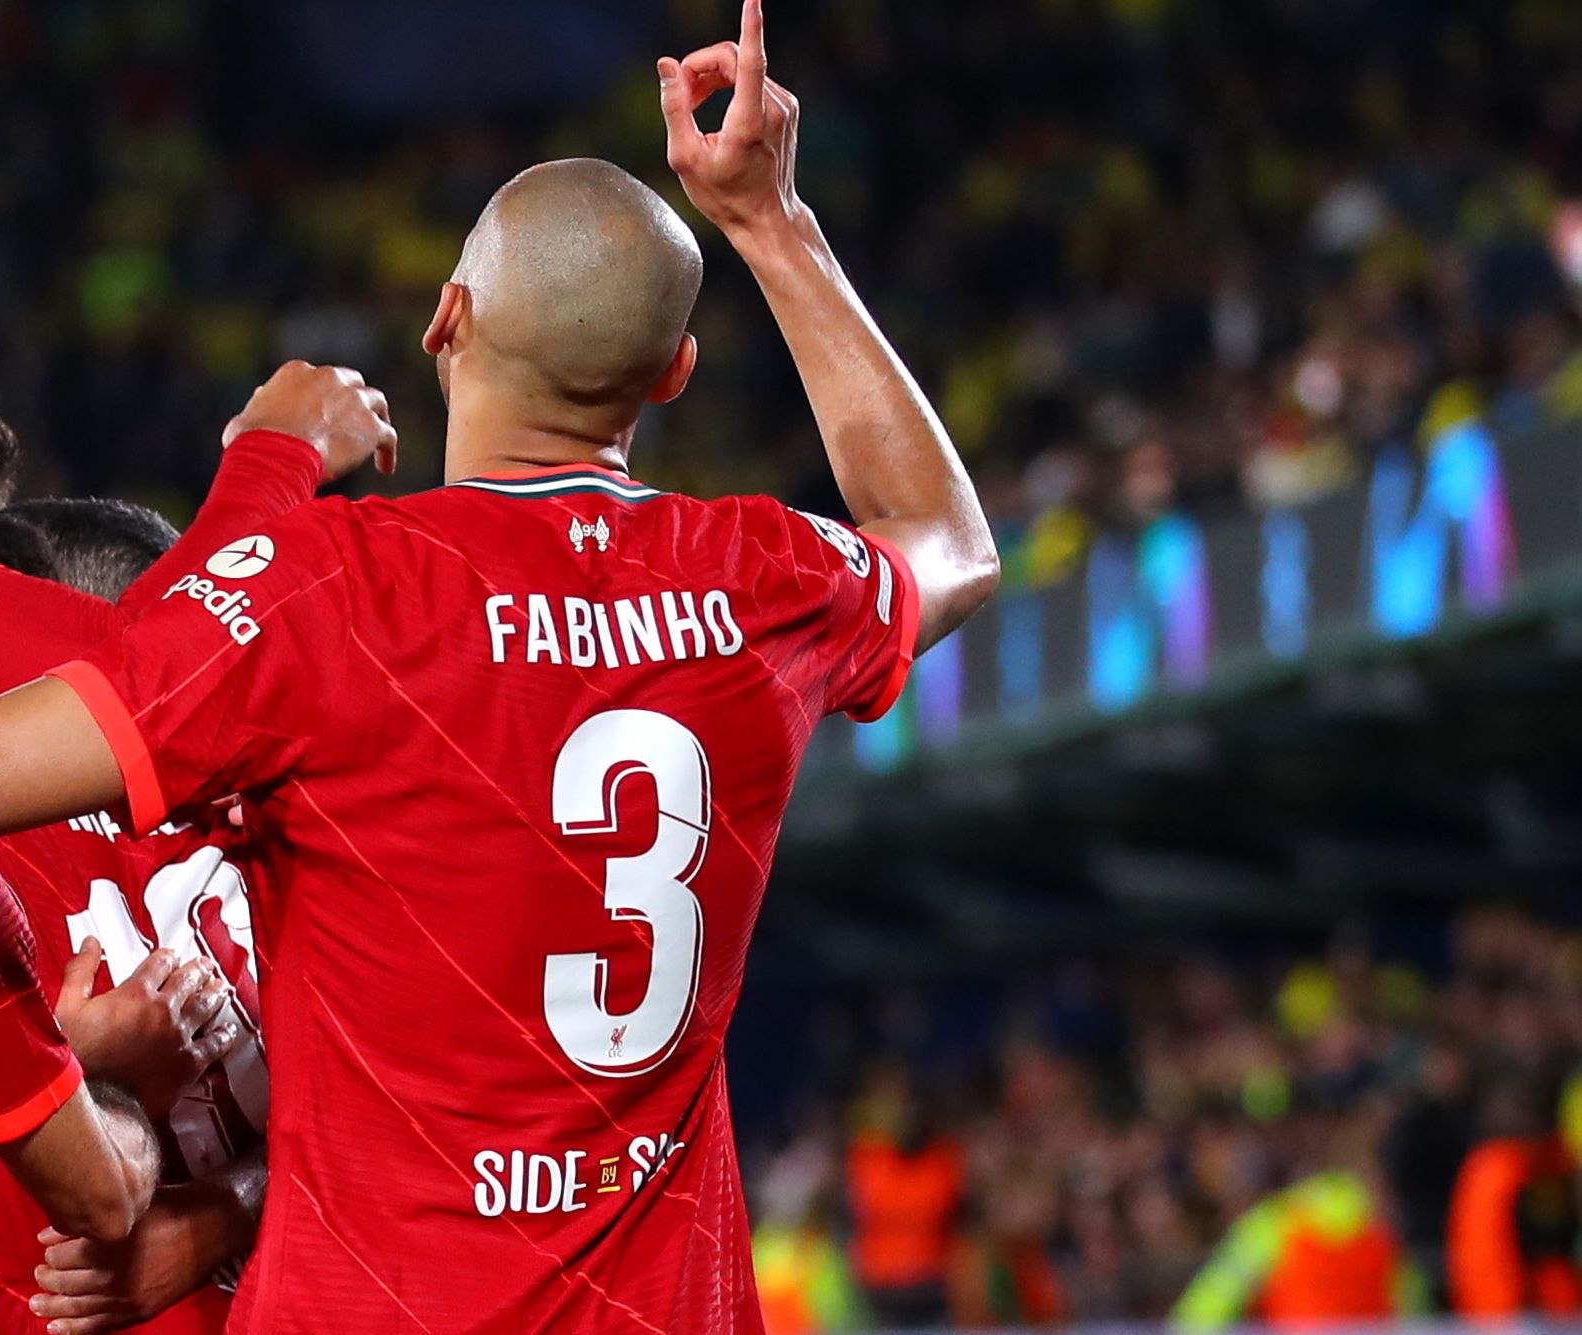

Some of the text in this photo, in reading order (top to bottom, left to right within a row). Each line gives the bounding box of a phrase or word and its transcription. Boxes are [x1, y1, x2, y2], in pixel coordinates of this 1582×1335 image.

[161, 574, 261, 646] pedia
[486, 590, 744, 669] FABINHO
[544, 709, 711, 1077] 3
[473, 1149, 587, 1217] SIDE
